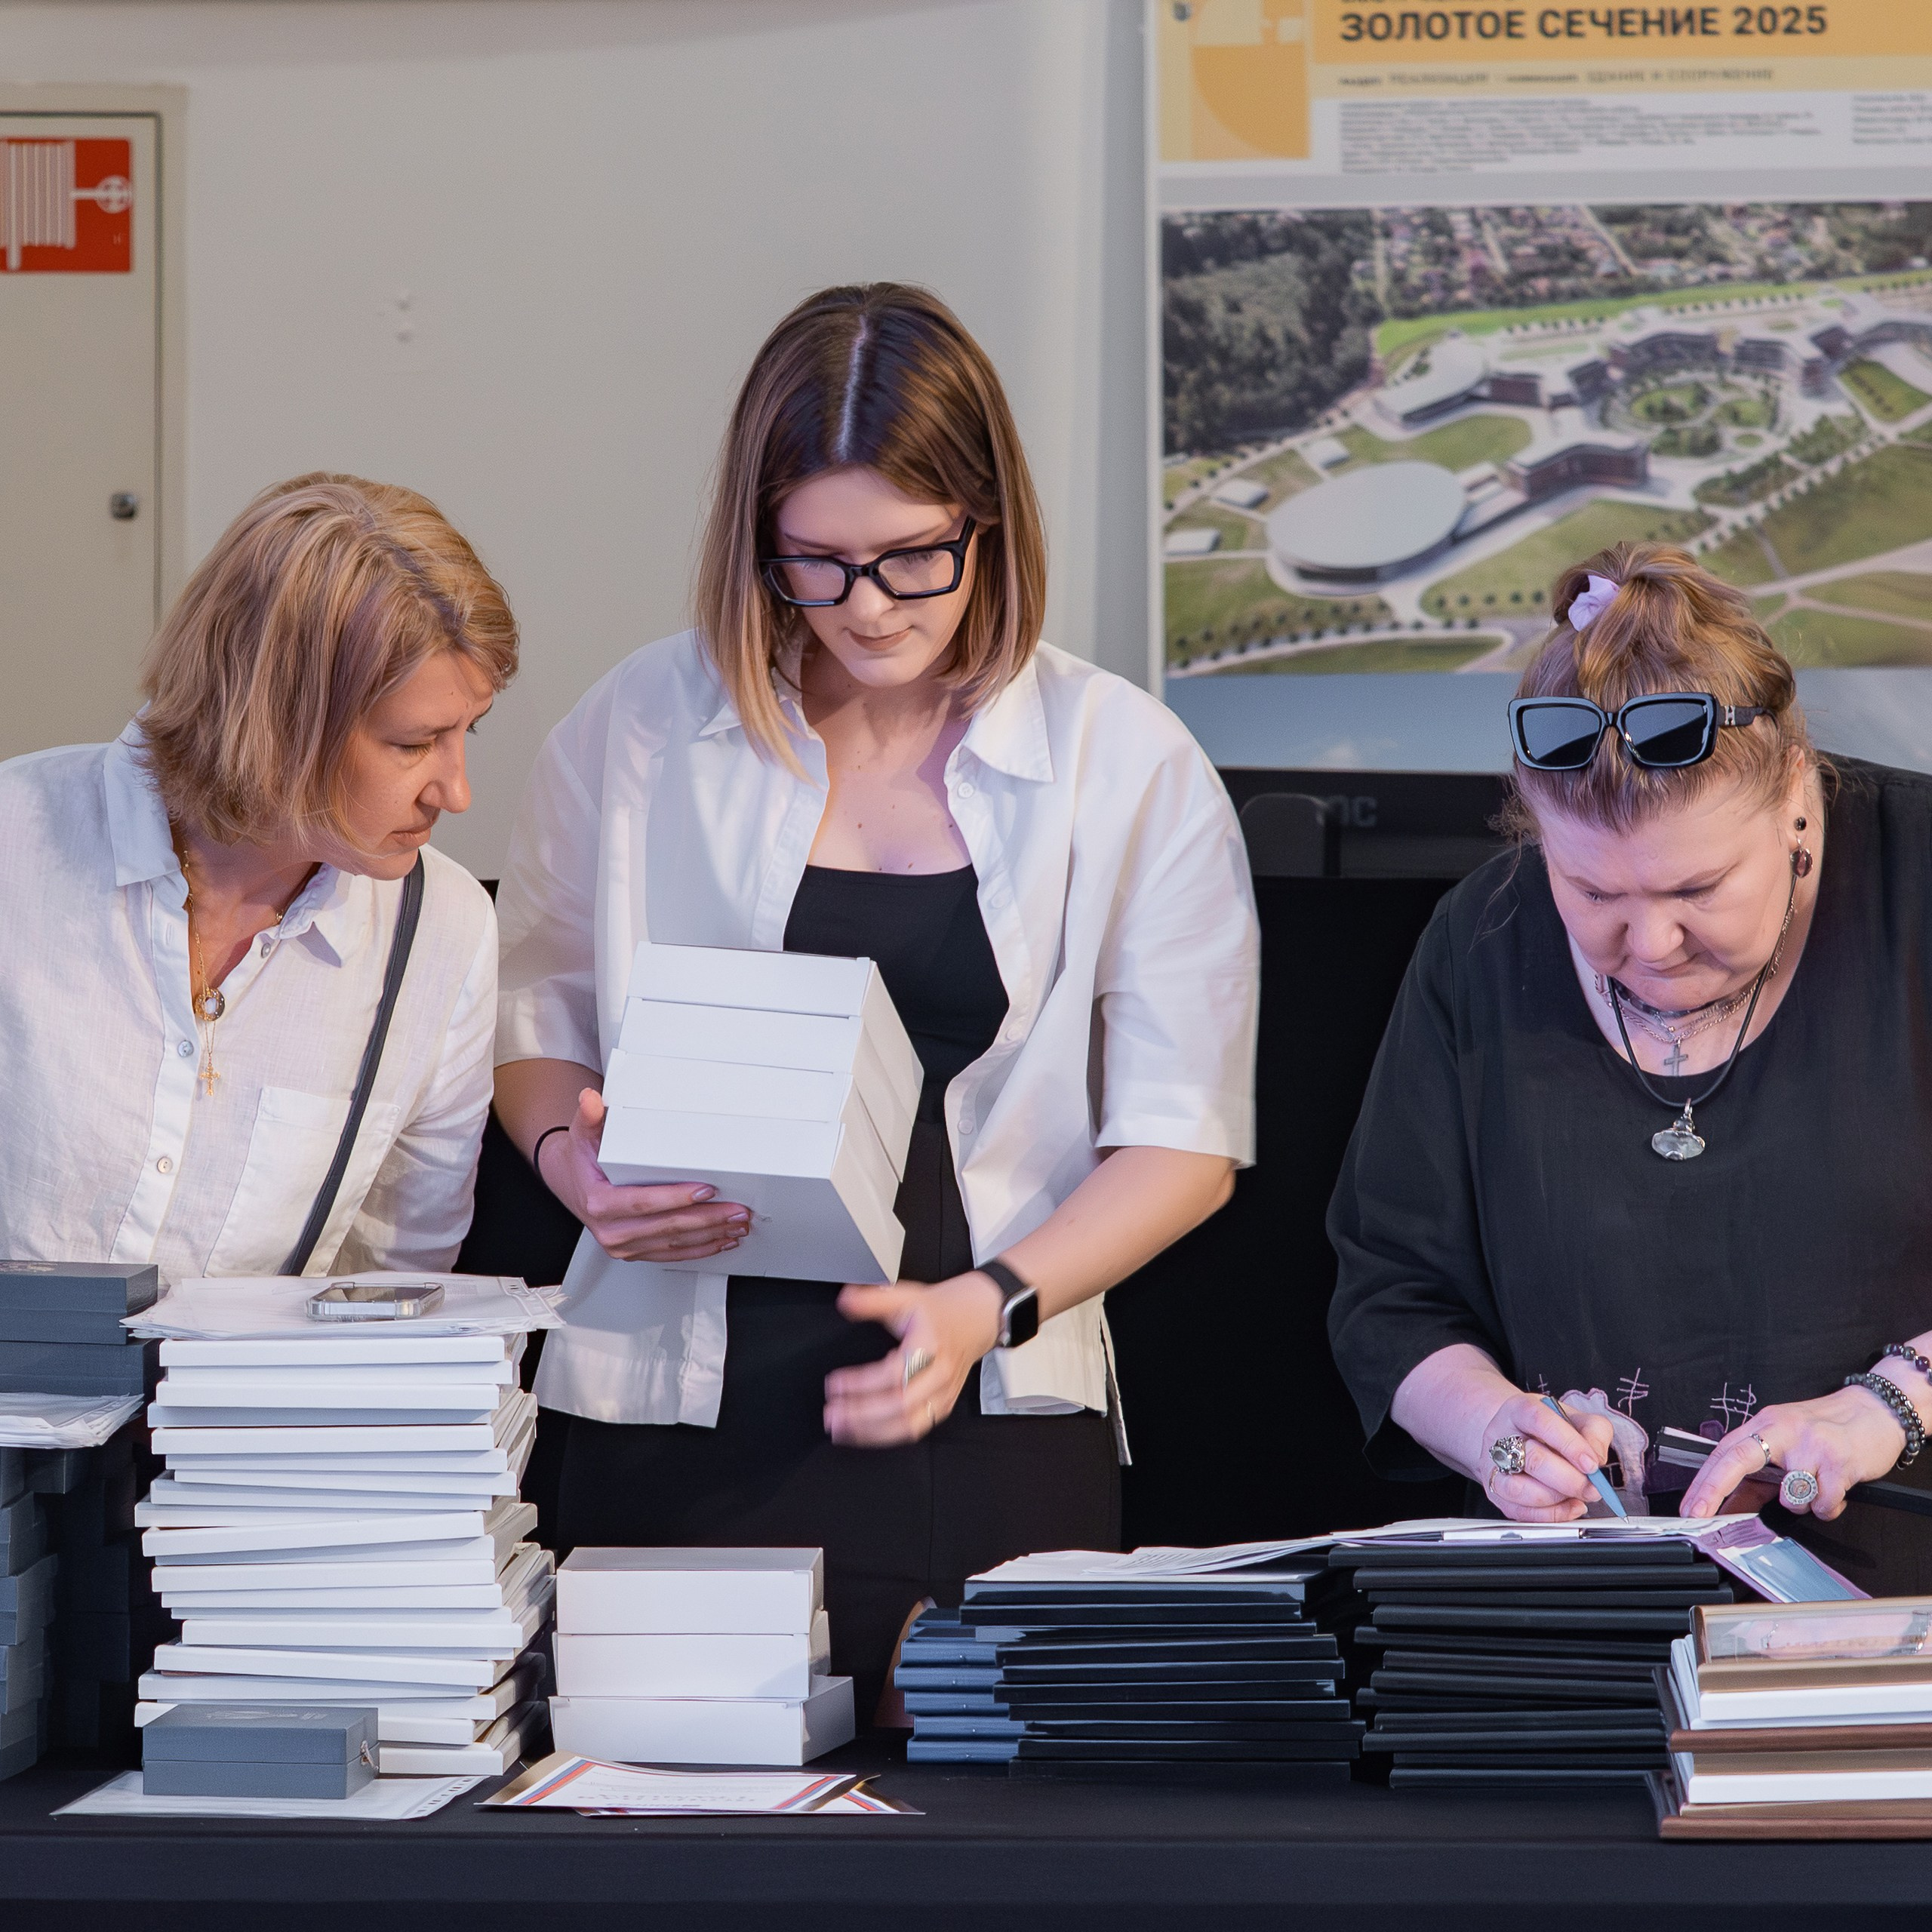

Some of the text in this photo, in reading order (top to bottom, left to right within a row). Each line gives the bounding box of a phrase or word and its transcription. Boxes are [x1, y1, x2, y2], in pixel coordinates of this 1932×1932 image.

[1341, 5, 1827, 42] ЗОЛОТОЕ СЕЧЕНИЕ 2025
